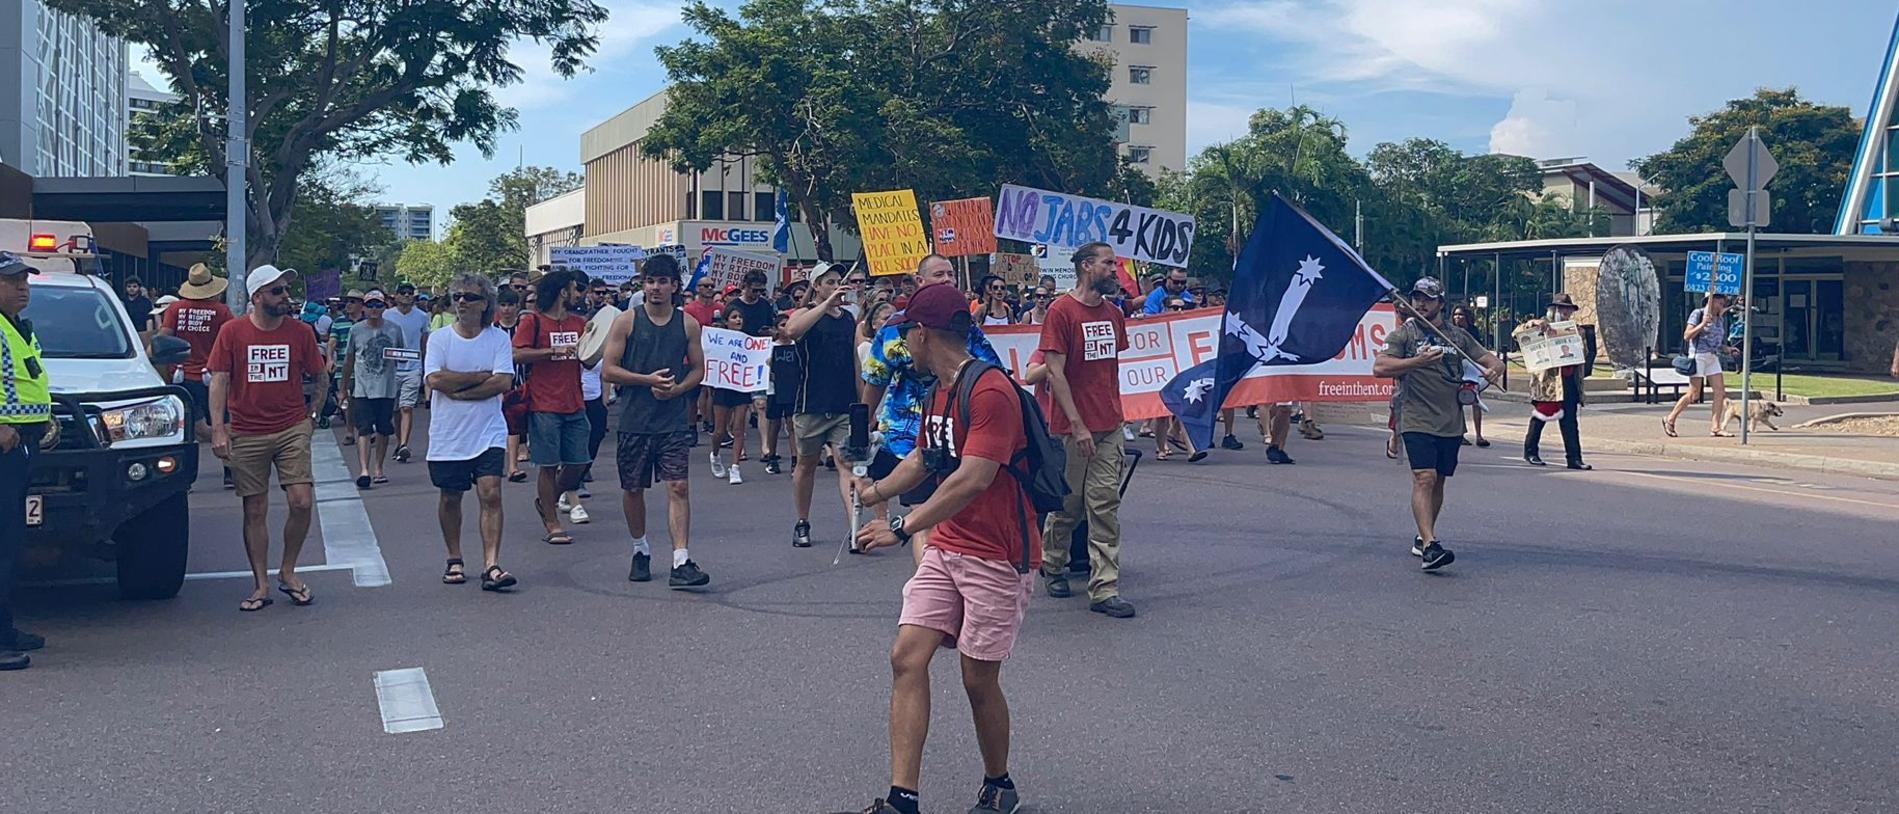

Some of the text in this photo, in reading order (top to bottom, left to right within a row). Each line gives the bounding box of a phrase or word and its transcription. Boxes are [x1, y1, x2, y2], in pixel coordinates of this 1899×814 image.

[857, 194, 908, 210] MEDICAL
[862, 208, 920, 225] MANDATES
[896, 223, 918, 238] NO
[997, 188, 1194, 264] NO JABS 4 KIDS
[702, 229, 769, 242] McGEES
[613, 247, 638, 255] FOUGHT
[901, 241, 913, 254] IN
[917, 240, 927, 254] A
[714, 253, 775, 271] MY FREEDOM
[1690, 253, 1713, 262] Cool
[713, 261, 726, 269] MY
[1696, 263, 1732, 273] Paining
[711, 270, 724, 279] MY
[189, 308, 217, 316] FREEDOM
[1085, 324, 1113, 337] FREE
[553, 334, 577, 344] FREE
[708, 332, 724, 345] WE
[728, 339, 743, 348] ARE
[1127, 331, 1161, 350] OR
[251, 348, 286, 360] FREE
[1100, 343, 1114, 356] NT
[730, 352, 748, 364] AND
[268, 366, 286, 378] NT
[706, 359, 764, 387] FREE!
[1127, 366, 1168, 386] OUR
[1318, 380, 1393, 396] freeinthent.or
